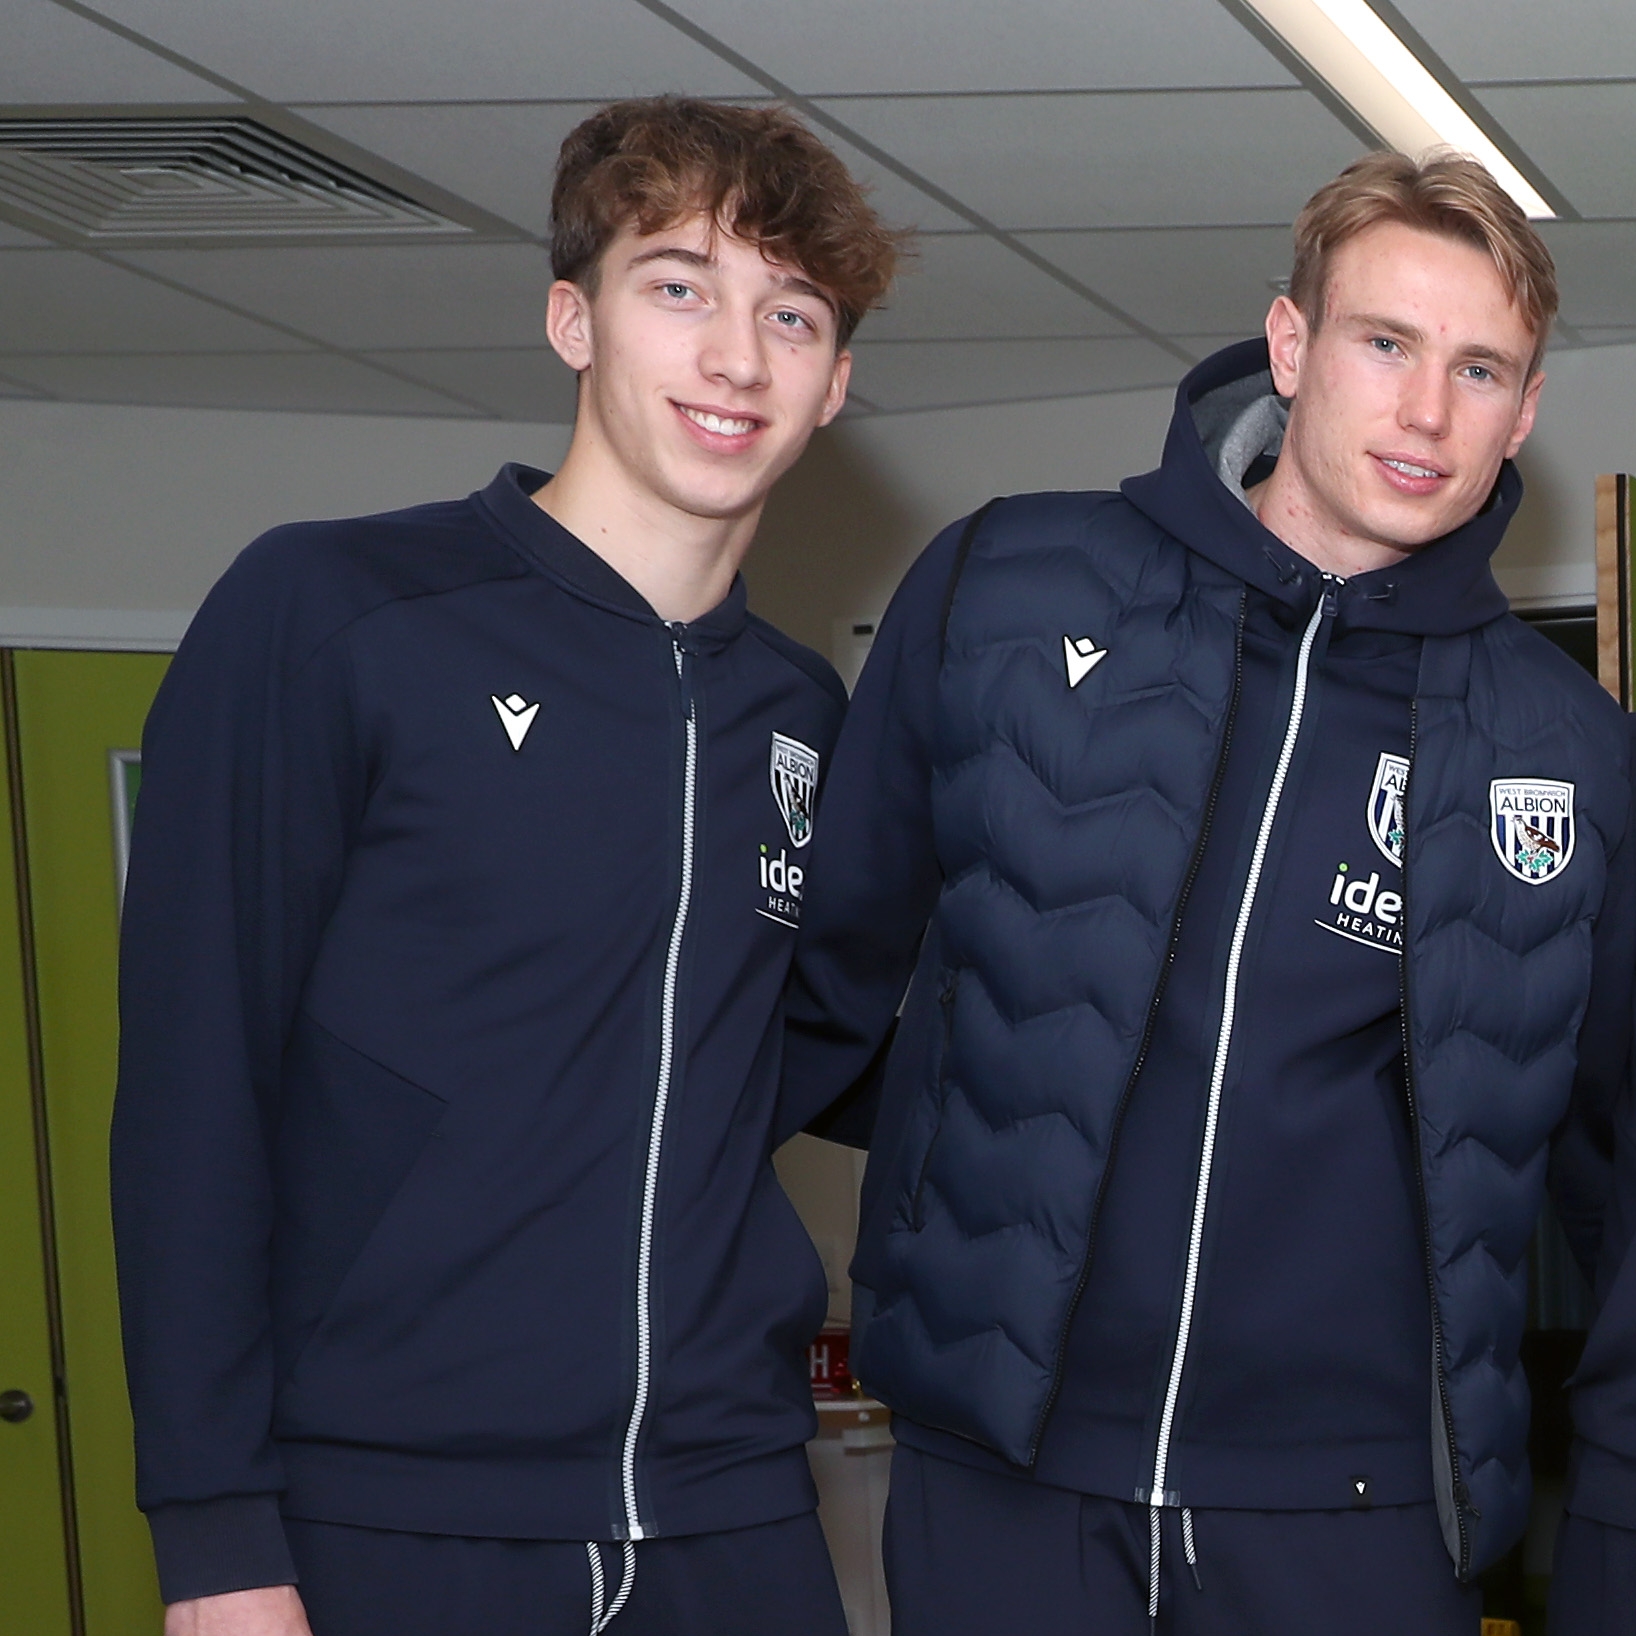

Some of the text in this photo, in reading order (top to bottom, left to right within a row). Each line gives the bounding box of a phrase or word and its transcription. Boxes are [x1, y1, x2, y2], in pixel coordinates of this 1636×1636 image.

[777, 753, 814, 782] ALBION
[1500, 797, 1566, 813] ALBION
[759, 844, 804, 900] ide
[1330, 863, 1402, 924] ide
